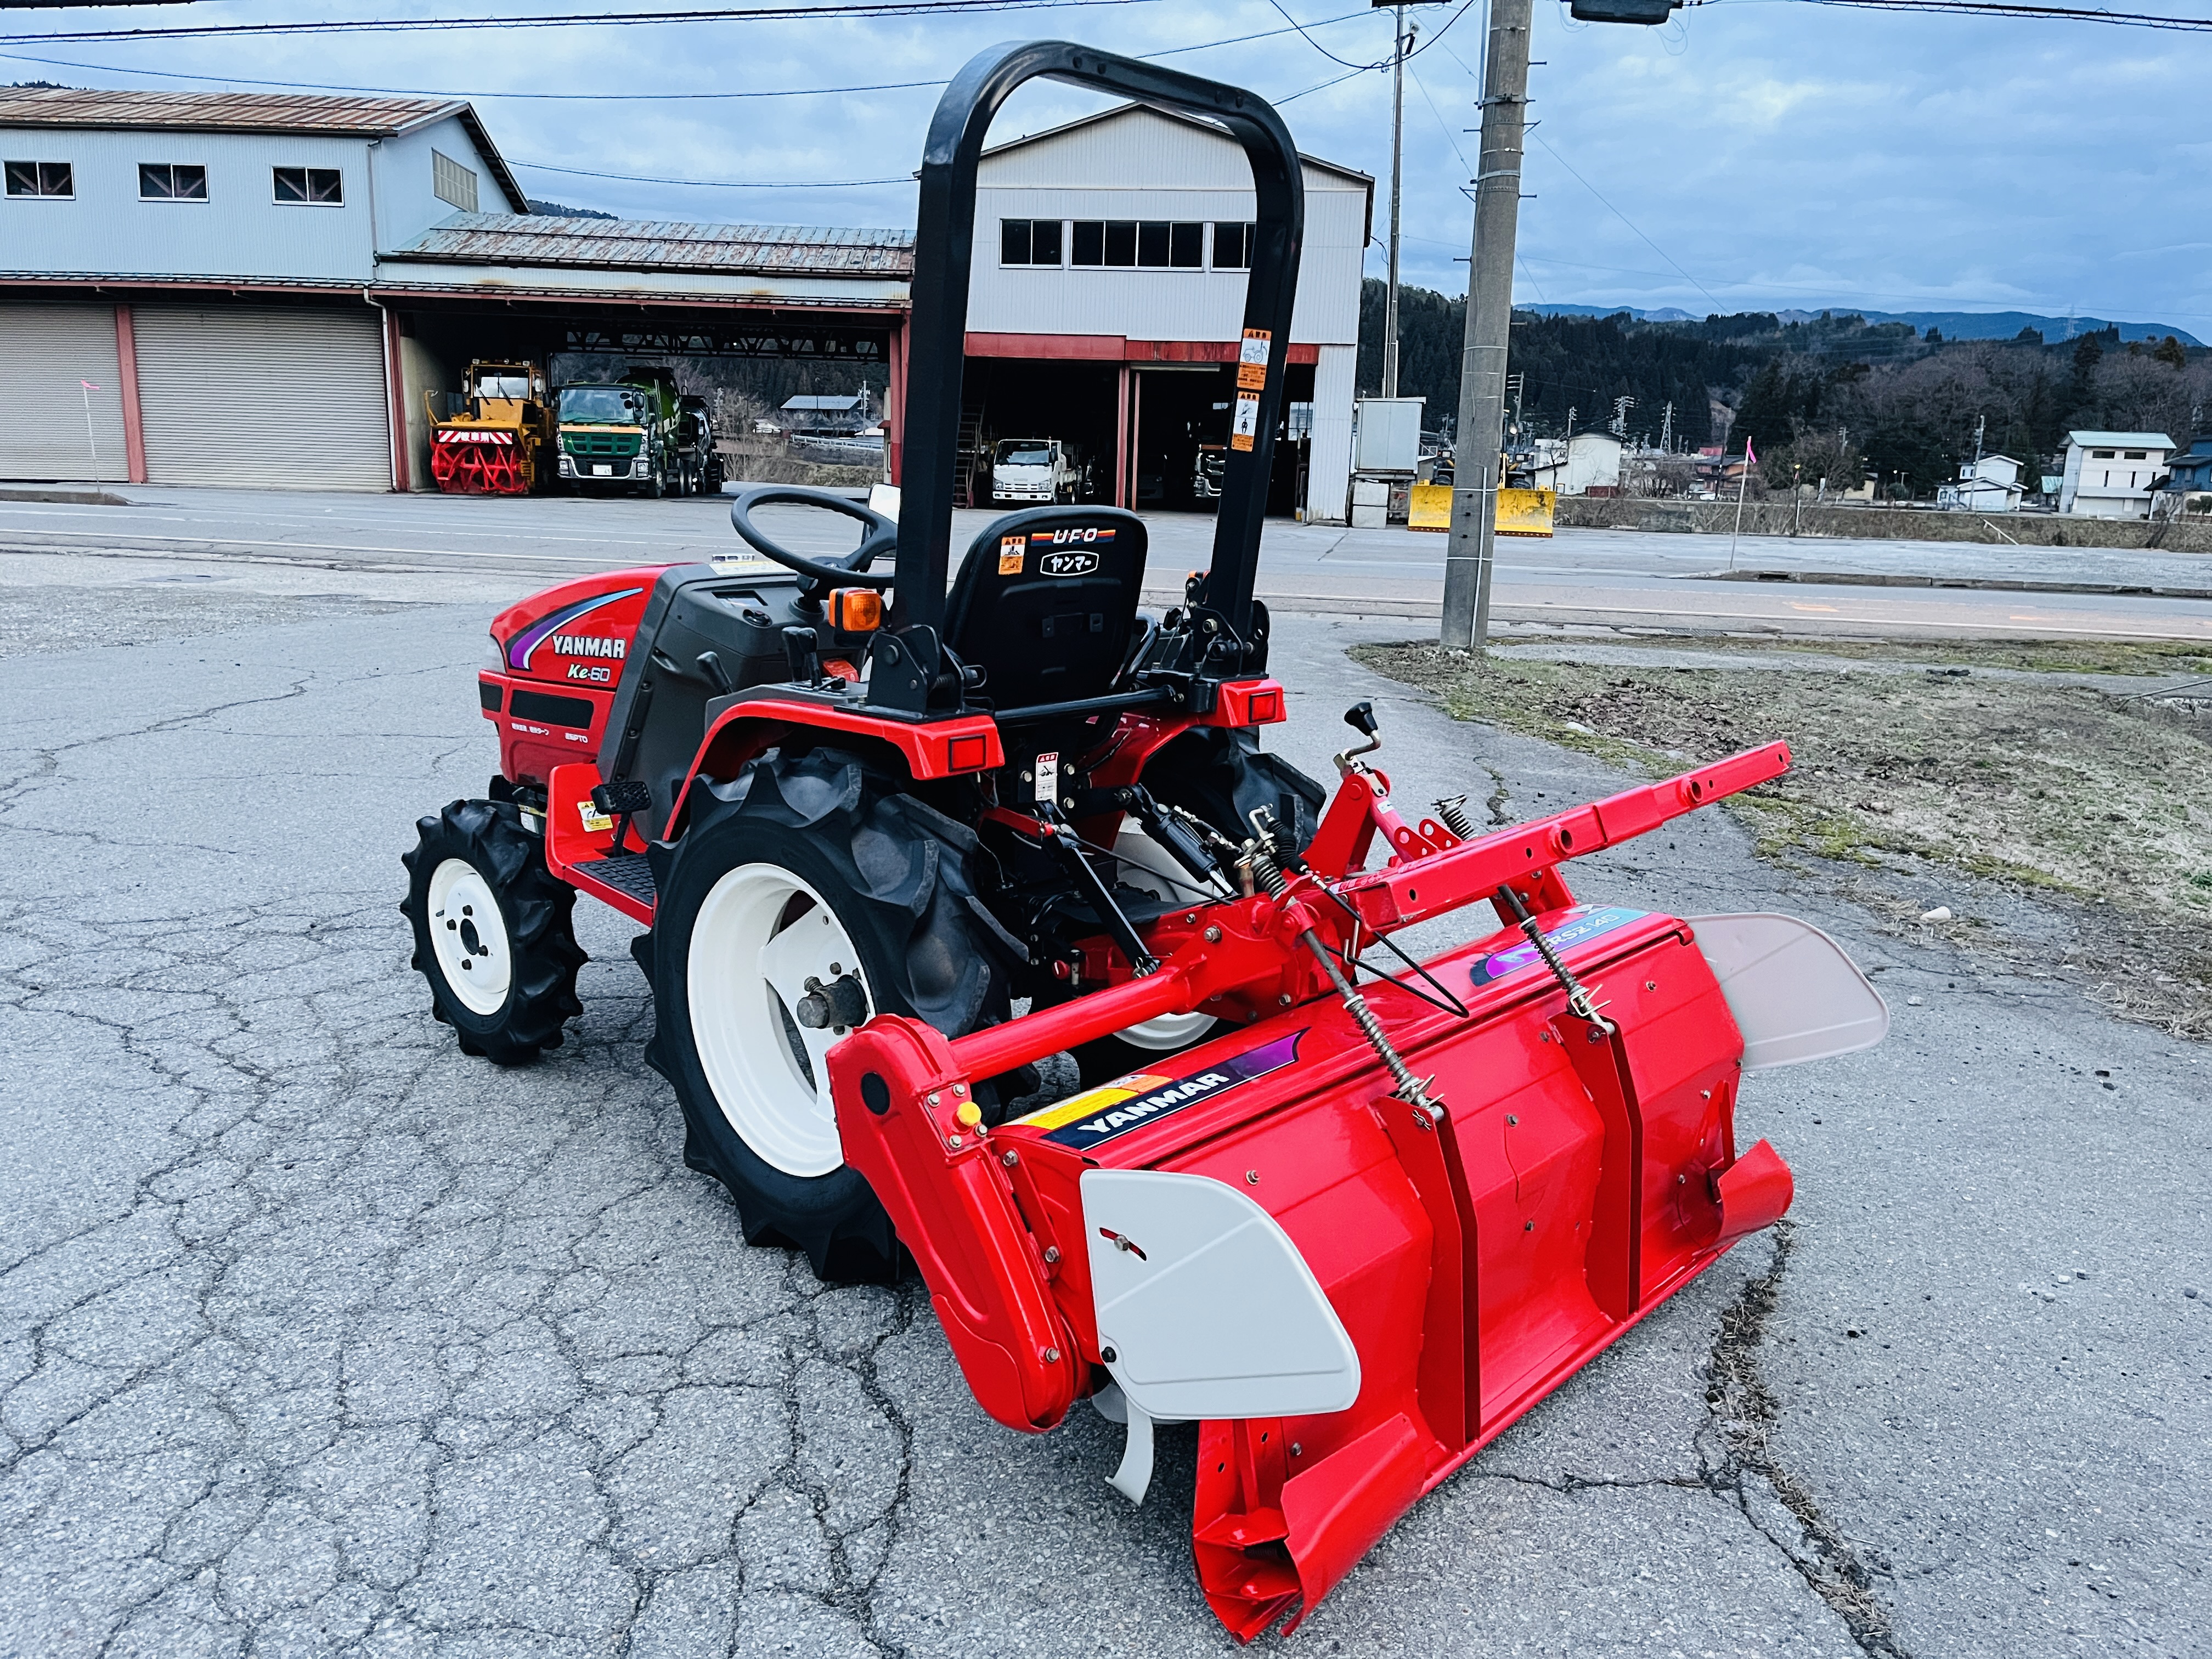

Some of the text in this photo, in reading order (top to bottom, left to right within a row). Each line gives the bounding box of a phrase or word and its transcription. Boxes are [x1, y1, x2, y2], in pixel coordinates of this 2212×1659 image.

[1051, 556, 1092, 572] ヤンマー
[552, 635, 625, 658] YANMAR
[1077, 1073, 1229, 1133] YANMAR
